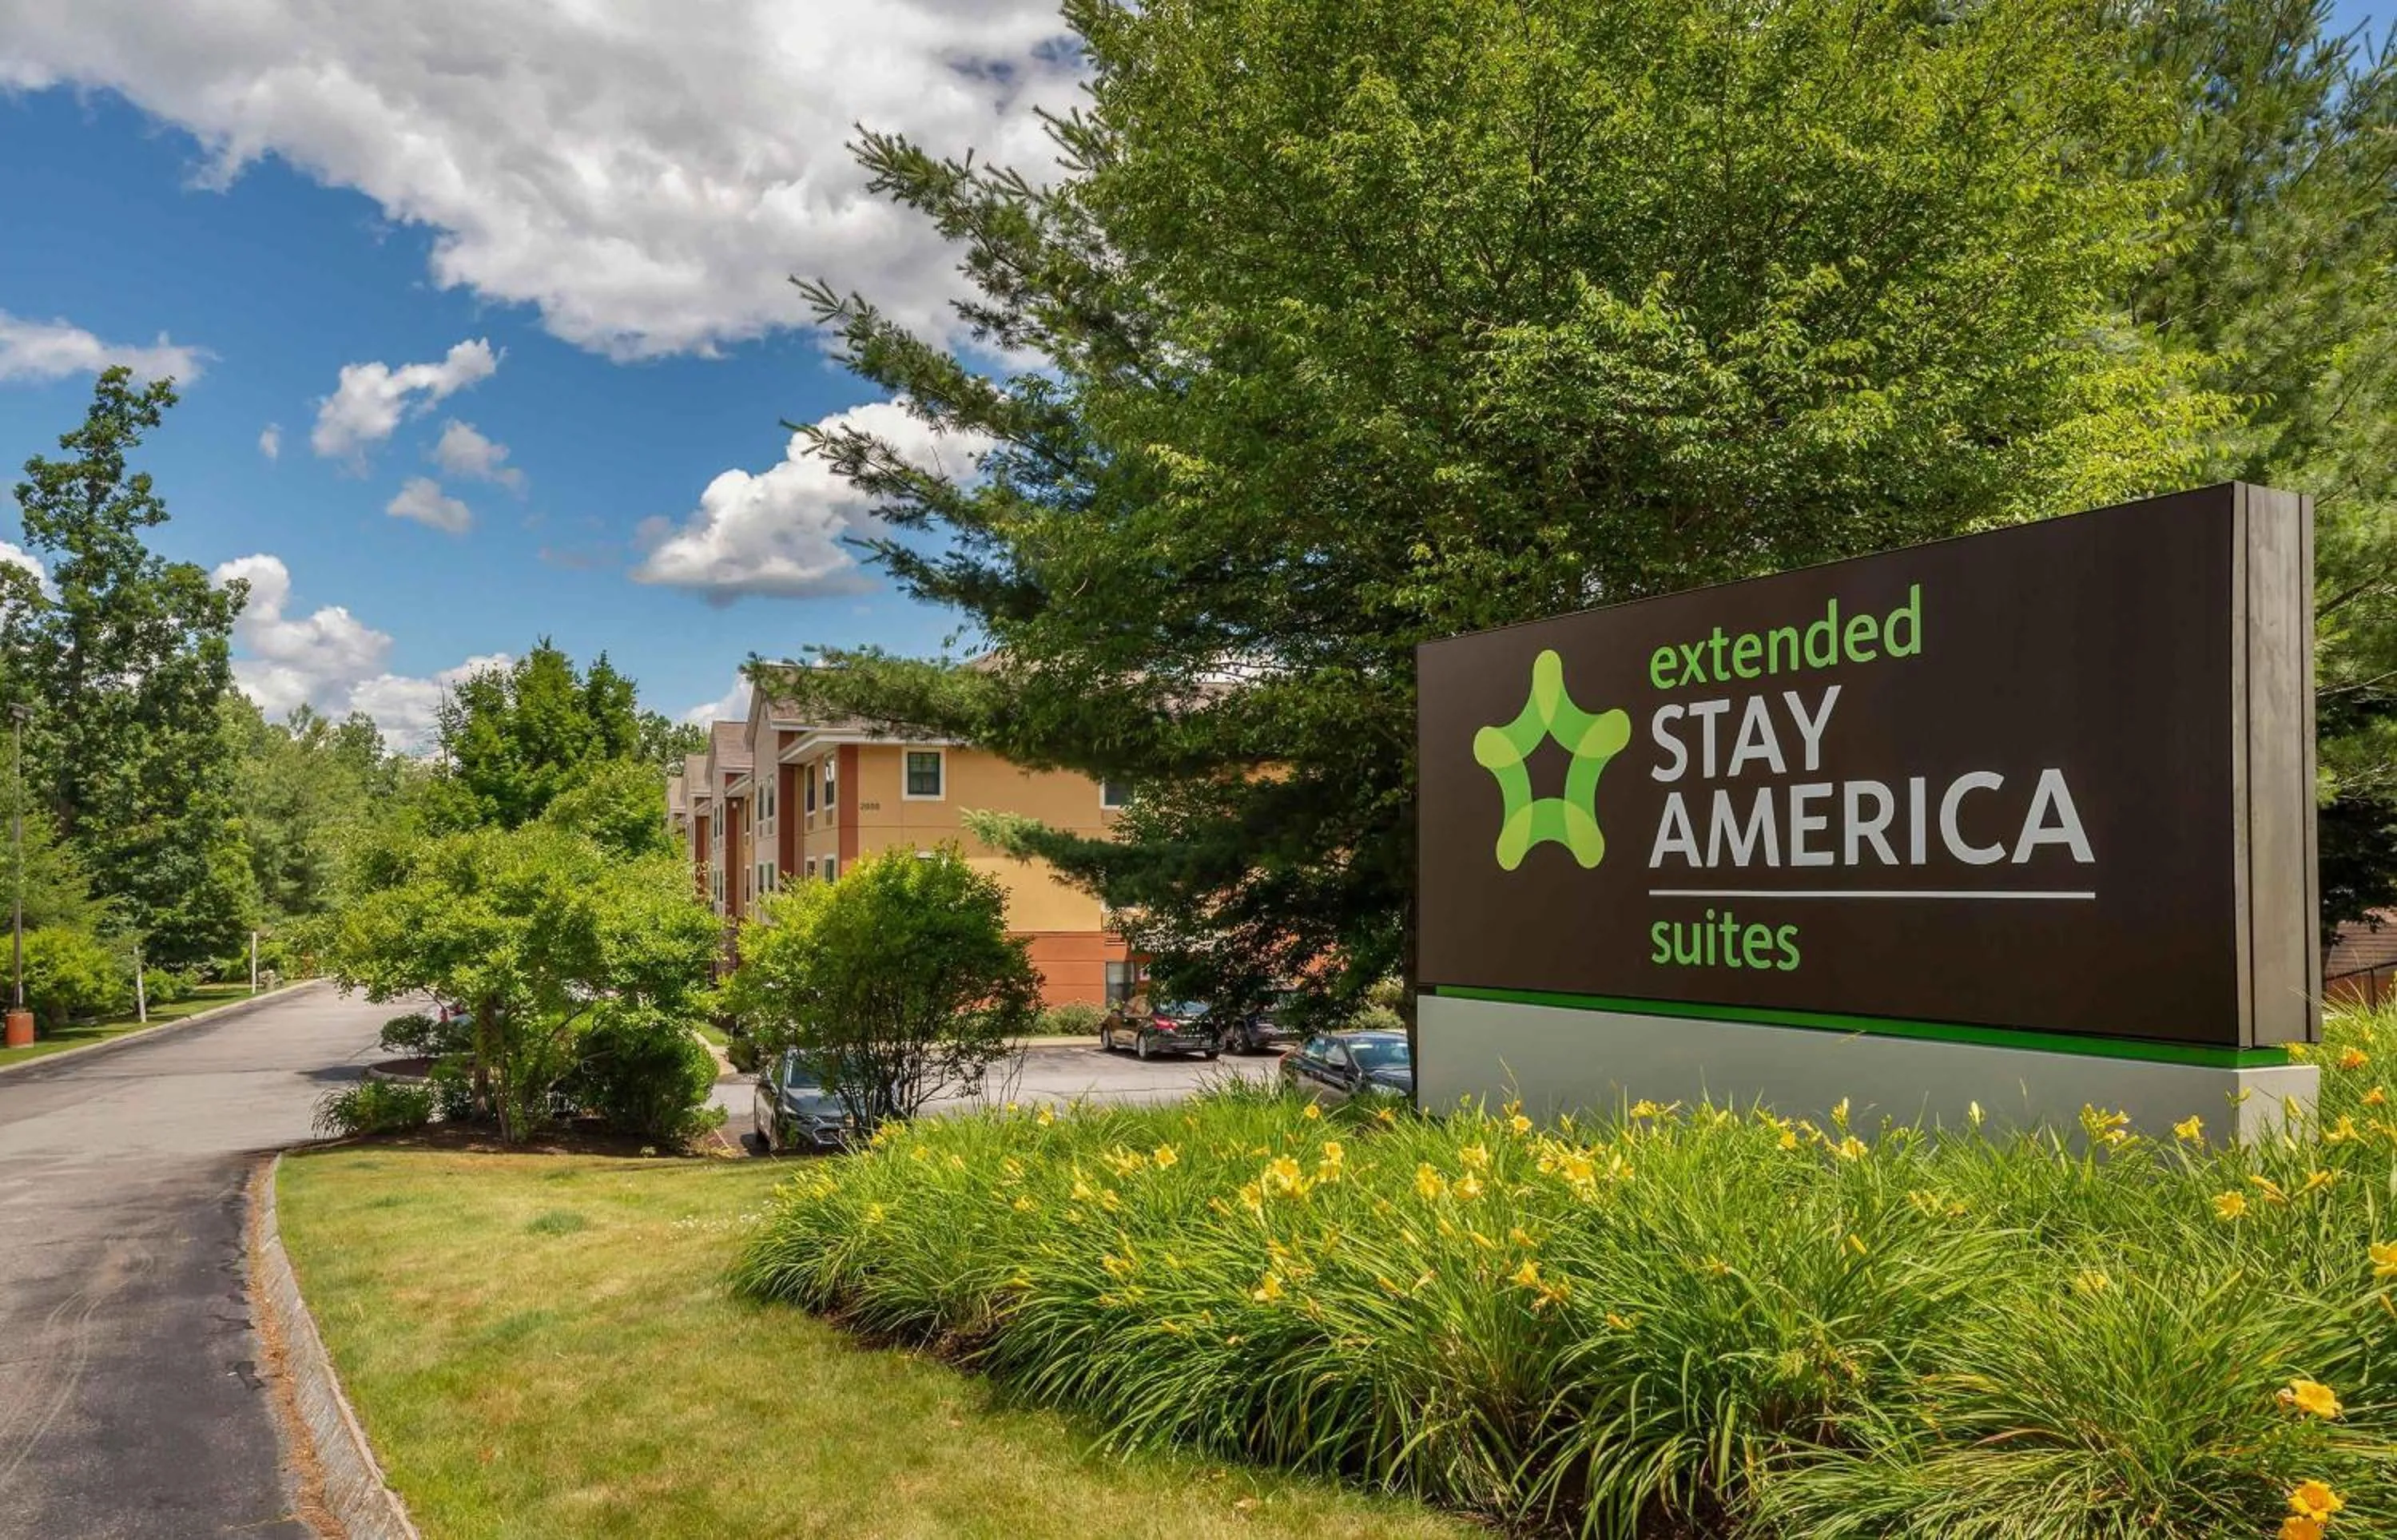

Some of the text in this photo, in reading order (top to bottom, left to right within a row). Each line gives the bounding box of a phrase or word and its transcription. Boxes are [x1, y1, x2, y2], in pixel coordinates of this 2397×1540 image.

[1650, 585, 1921, 689] extended
[1652, 685, 1841, 781] STAY
[1649, 768, 2095, 867] AMERICA
[1652, 910, 1800, 971] suites
